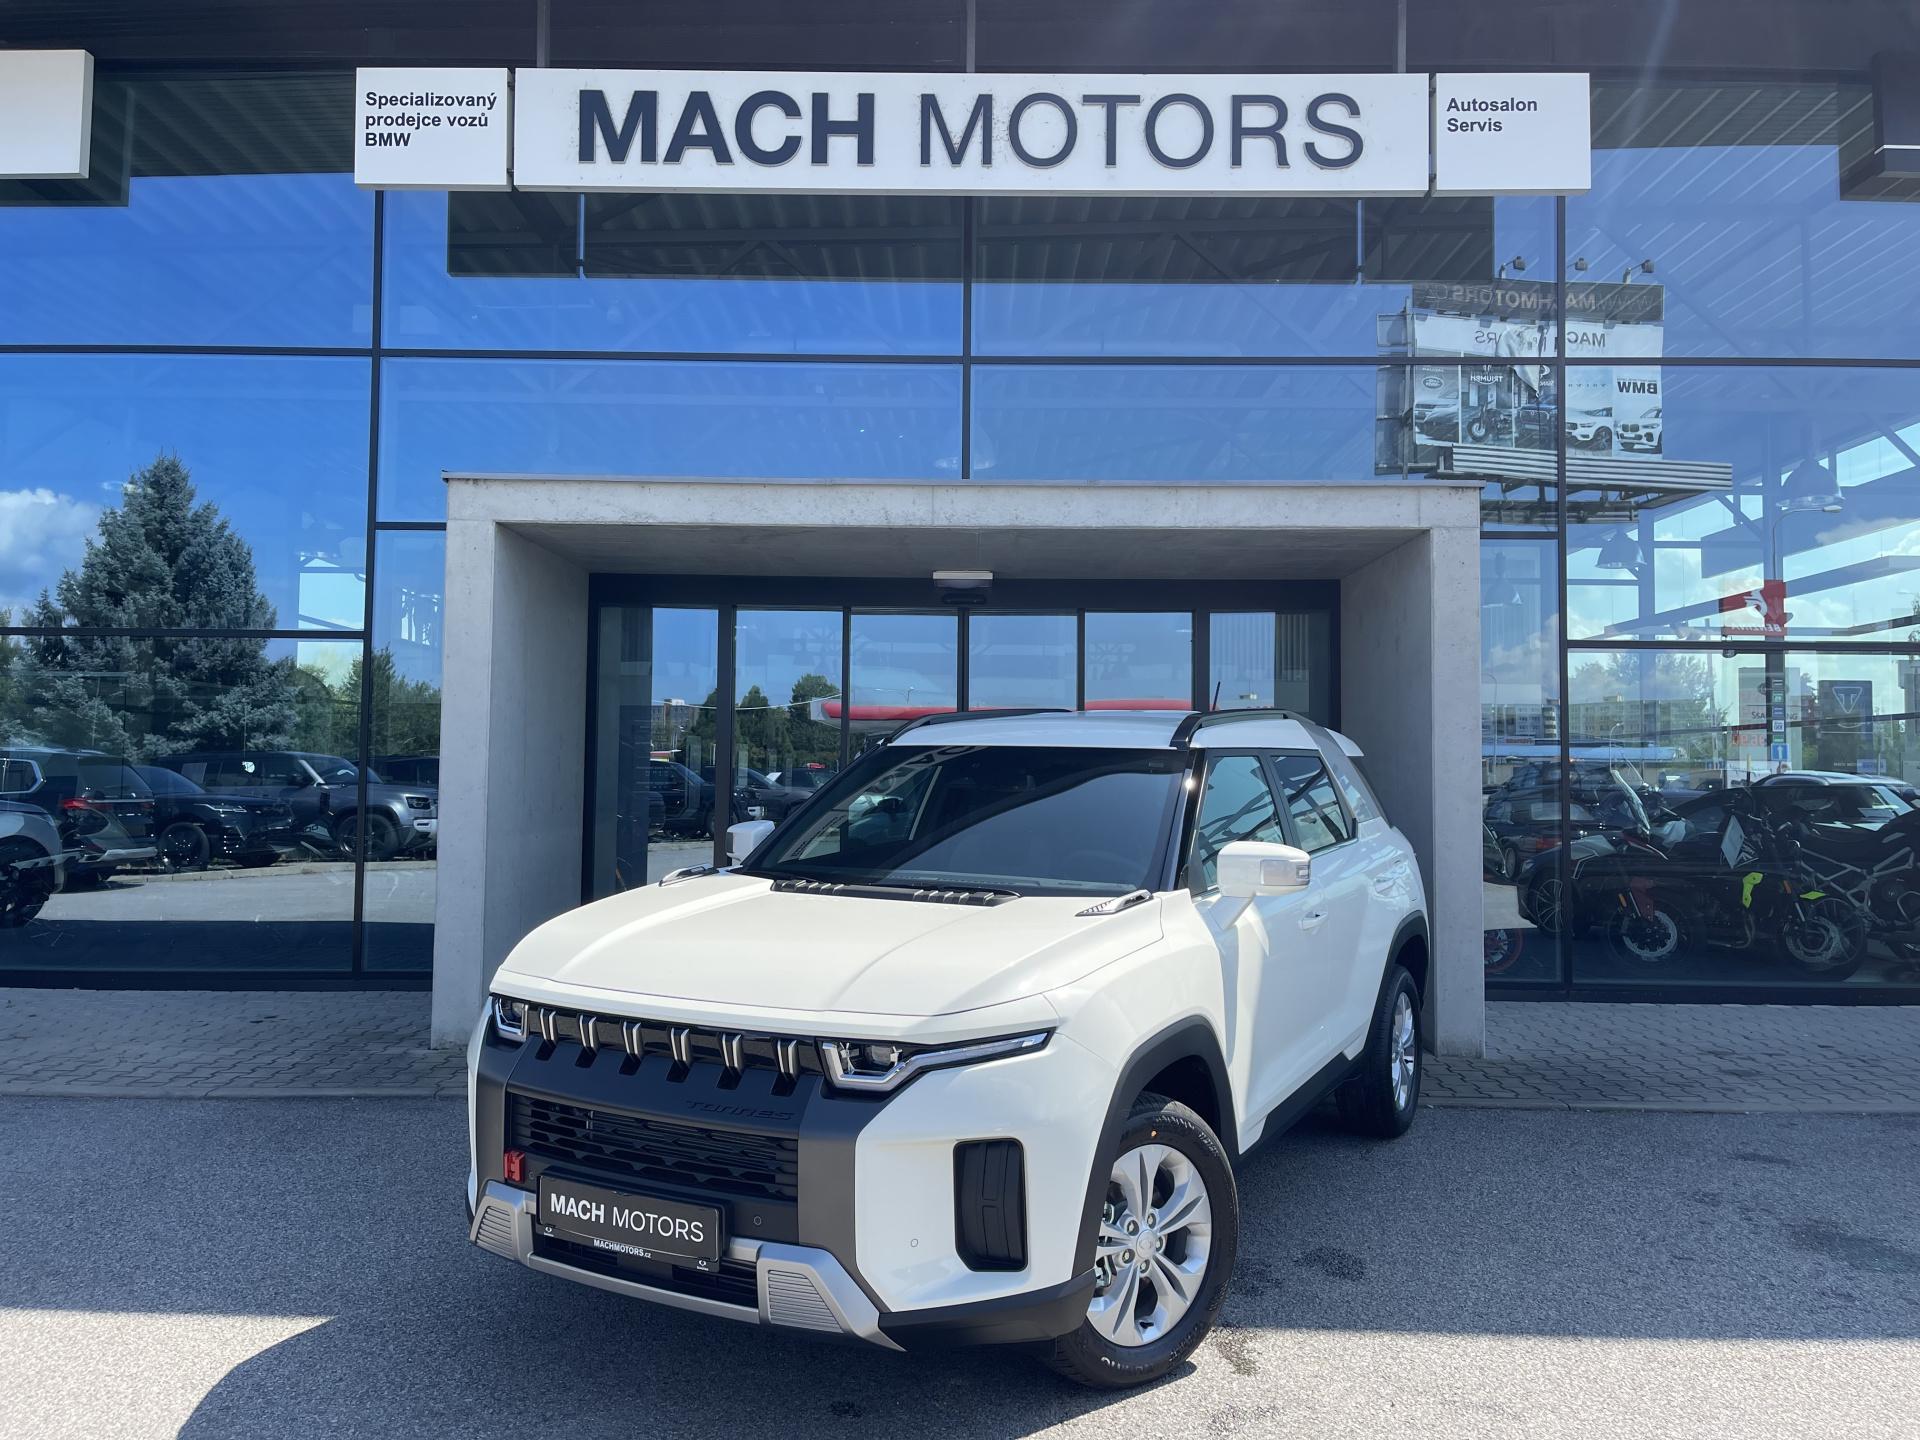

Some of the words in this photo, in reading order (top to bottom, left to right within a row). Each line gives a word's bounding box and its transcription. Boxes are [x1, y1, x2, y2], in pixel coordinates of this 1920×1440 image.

[365, 91, 497, 110] Specializovaný
[1446, 97, 1538, 112] Autosalon
[365, 112, 442, 130] prodejce
[447, 112, 489, 127] vozů
[577, 88, 876, 167] MACH
[919, 91, 1364, 169] MOTORS
[1447, 117, 1503, 132] Servis
[365, 132, 411, 147] BMW
[551, 1193, 604, 1224] MACH
[612, 1206, 704, 1242] MOTORS
